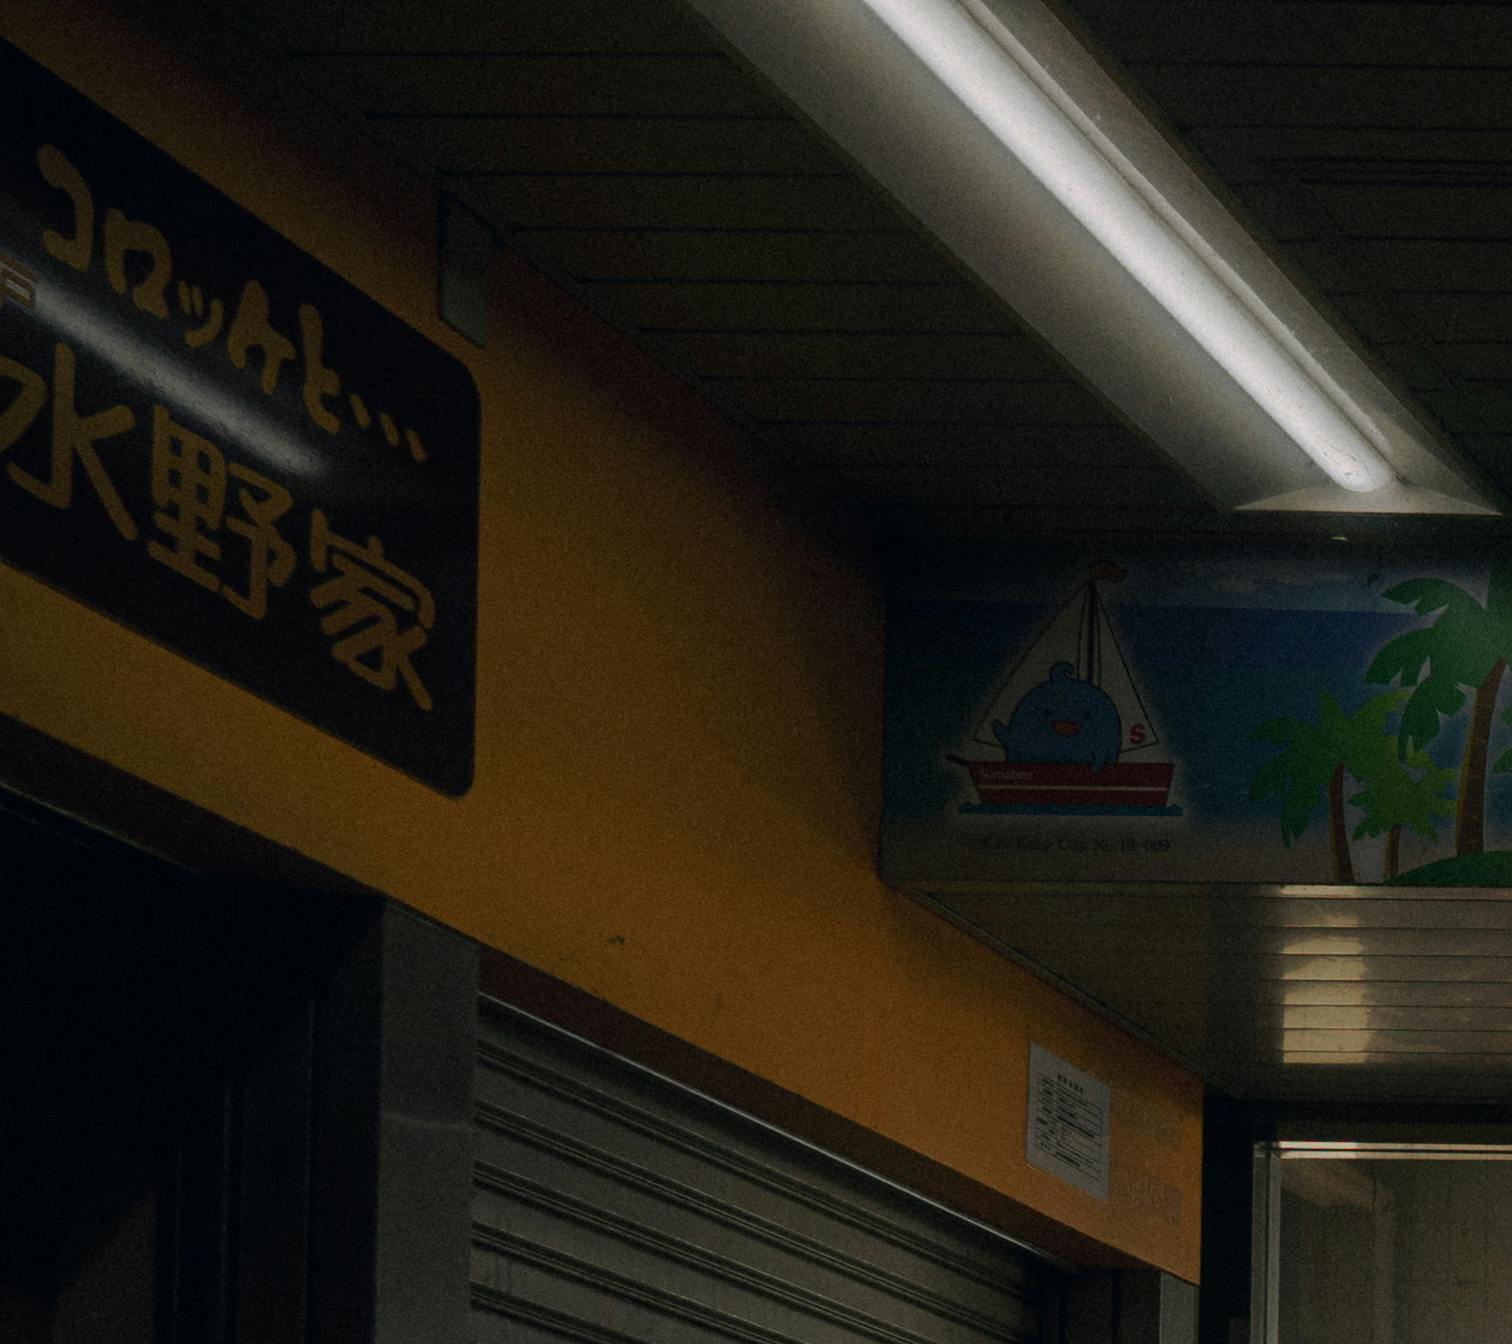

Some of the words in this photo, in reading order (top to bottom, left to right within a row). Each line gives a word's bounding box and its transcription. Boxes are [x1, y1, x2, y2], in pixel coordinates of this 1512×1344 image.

[0, 342, 436, 713] 水野家
[1129, 723, 1146, 745] S
